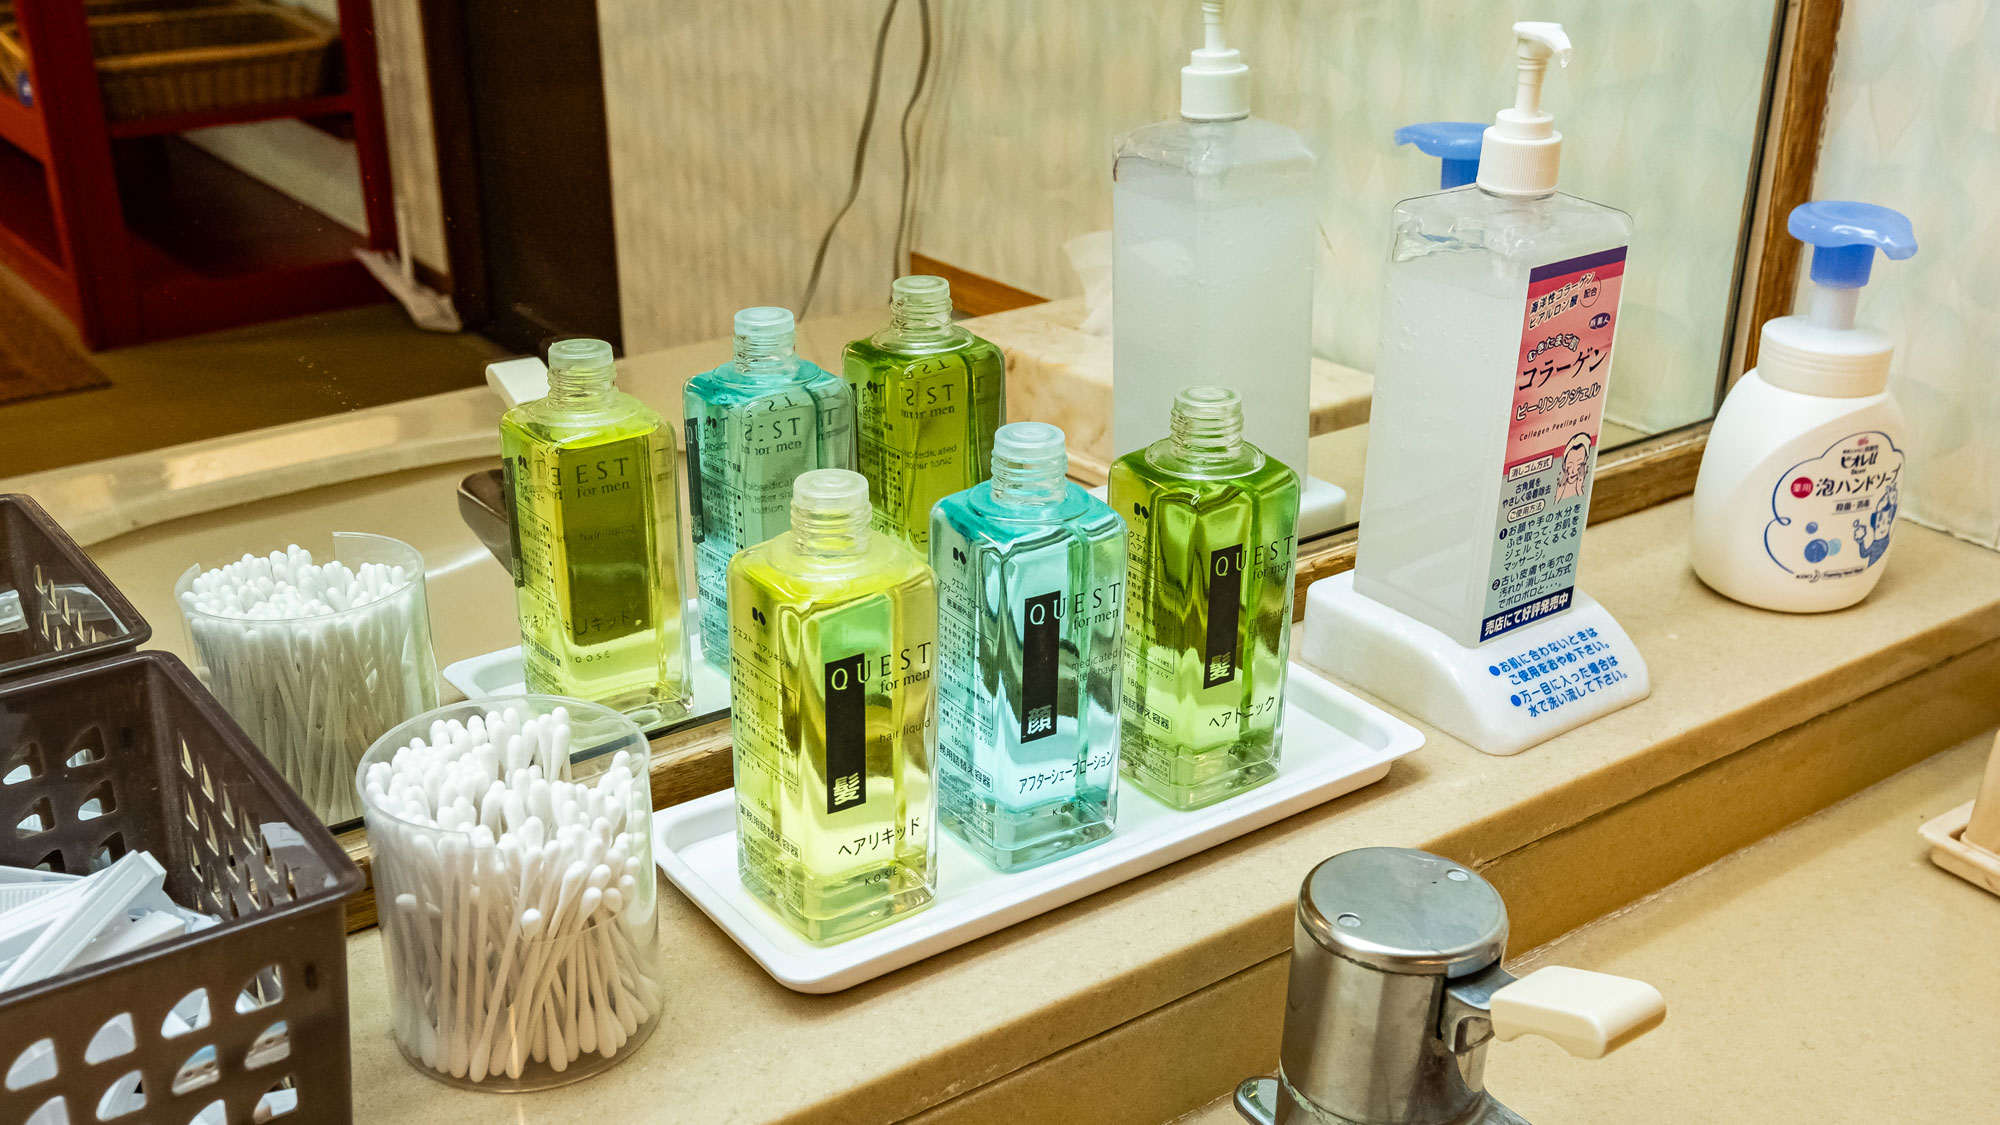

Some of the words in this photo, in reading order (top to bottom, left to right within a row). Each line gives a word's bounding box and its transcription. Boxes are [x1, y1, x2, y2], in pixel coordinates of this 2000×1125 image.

[1530, 272, 1595, 315] 海洋性コラーゲン
[1529, 294, 1579, 330] ヒアルロン酸
[1519, 347, 1608, 391] コラーゲン
[1516, 382, 1601, 421] ピーリングジェル
[1519, 427, 1550, 441] Collagen
[1552, 419, 1577, 431] Peeling
[1579, 415, 1591, 425] Gel
[1511, 458, 1551, 478] 消しゴム方式
[602, 481, 630, 494] men
[1515, 478, 1541, 494] 古角質を
[1509, 502, 1543, 520] ご使用方法
[1215, 536, 1294, 577] QUEST
[1503, 550, 1546, 571] マッサージ。
[1504, 527, 1578, 562] ジェルでくるくる
[1253, 569, 1267, 580] for
[1271, 560, 1292, 574] men
[1030, 582, 1121, 626] QUEST
[1073, 616, 1091, 630] for
[1094, 608, 1119, 624] men
[1484, 592, 1569, 636] 売店にて好評発売中
[831, 641, 931, 691] QUEST
[1210, 651, 1231, 681] 髪
[1498, 627, 1599, 674] お肌に合わないときは
[1508, 640, 1610, 686] ご使用をおやめ下さい。
[880, 679, 899, 694] for
[903, 669, 930, 686] men
[1127, 677, 1146, 693] 180ml
[1519, 655, 1619, 704] 万一目に入った場合は
[1527, 669, 1628, 718] 水で洗い流して下さい。
[1027, 704, 1052, 734] 顔
[1209, 696, 1275, 728] ヘアトニック
[880, 729, 899, 743] hair
[903, 718, 931, 736] liquid
[951, 735, 970, 754] 180ml
[833, 772, 860, 806] 髪
[757, 798, 776, 817] 180ml
[838, 817, 920, 856] ヘアリキッド
